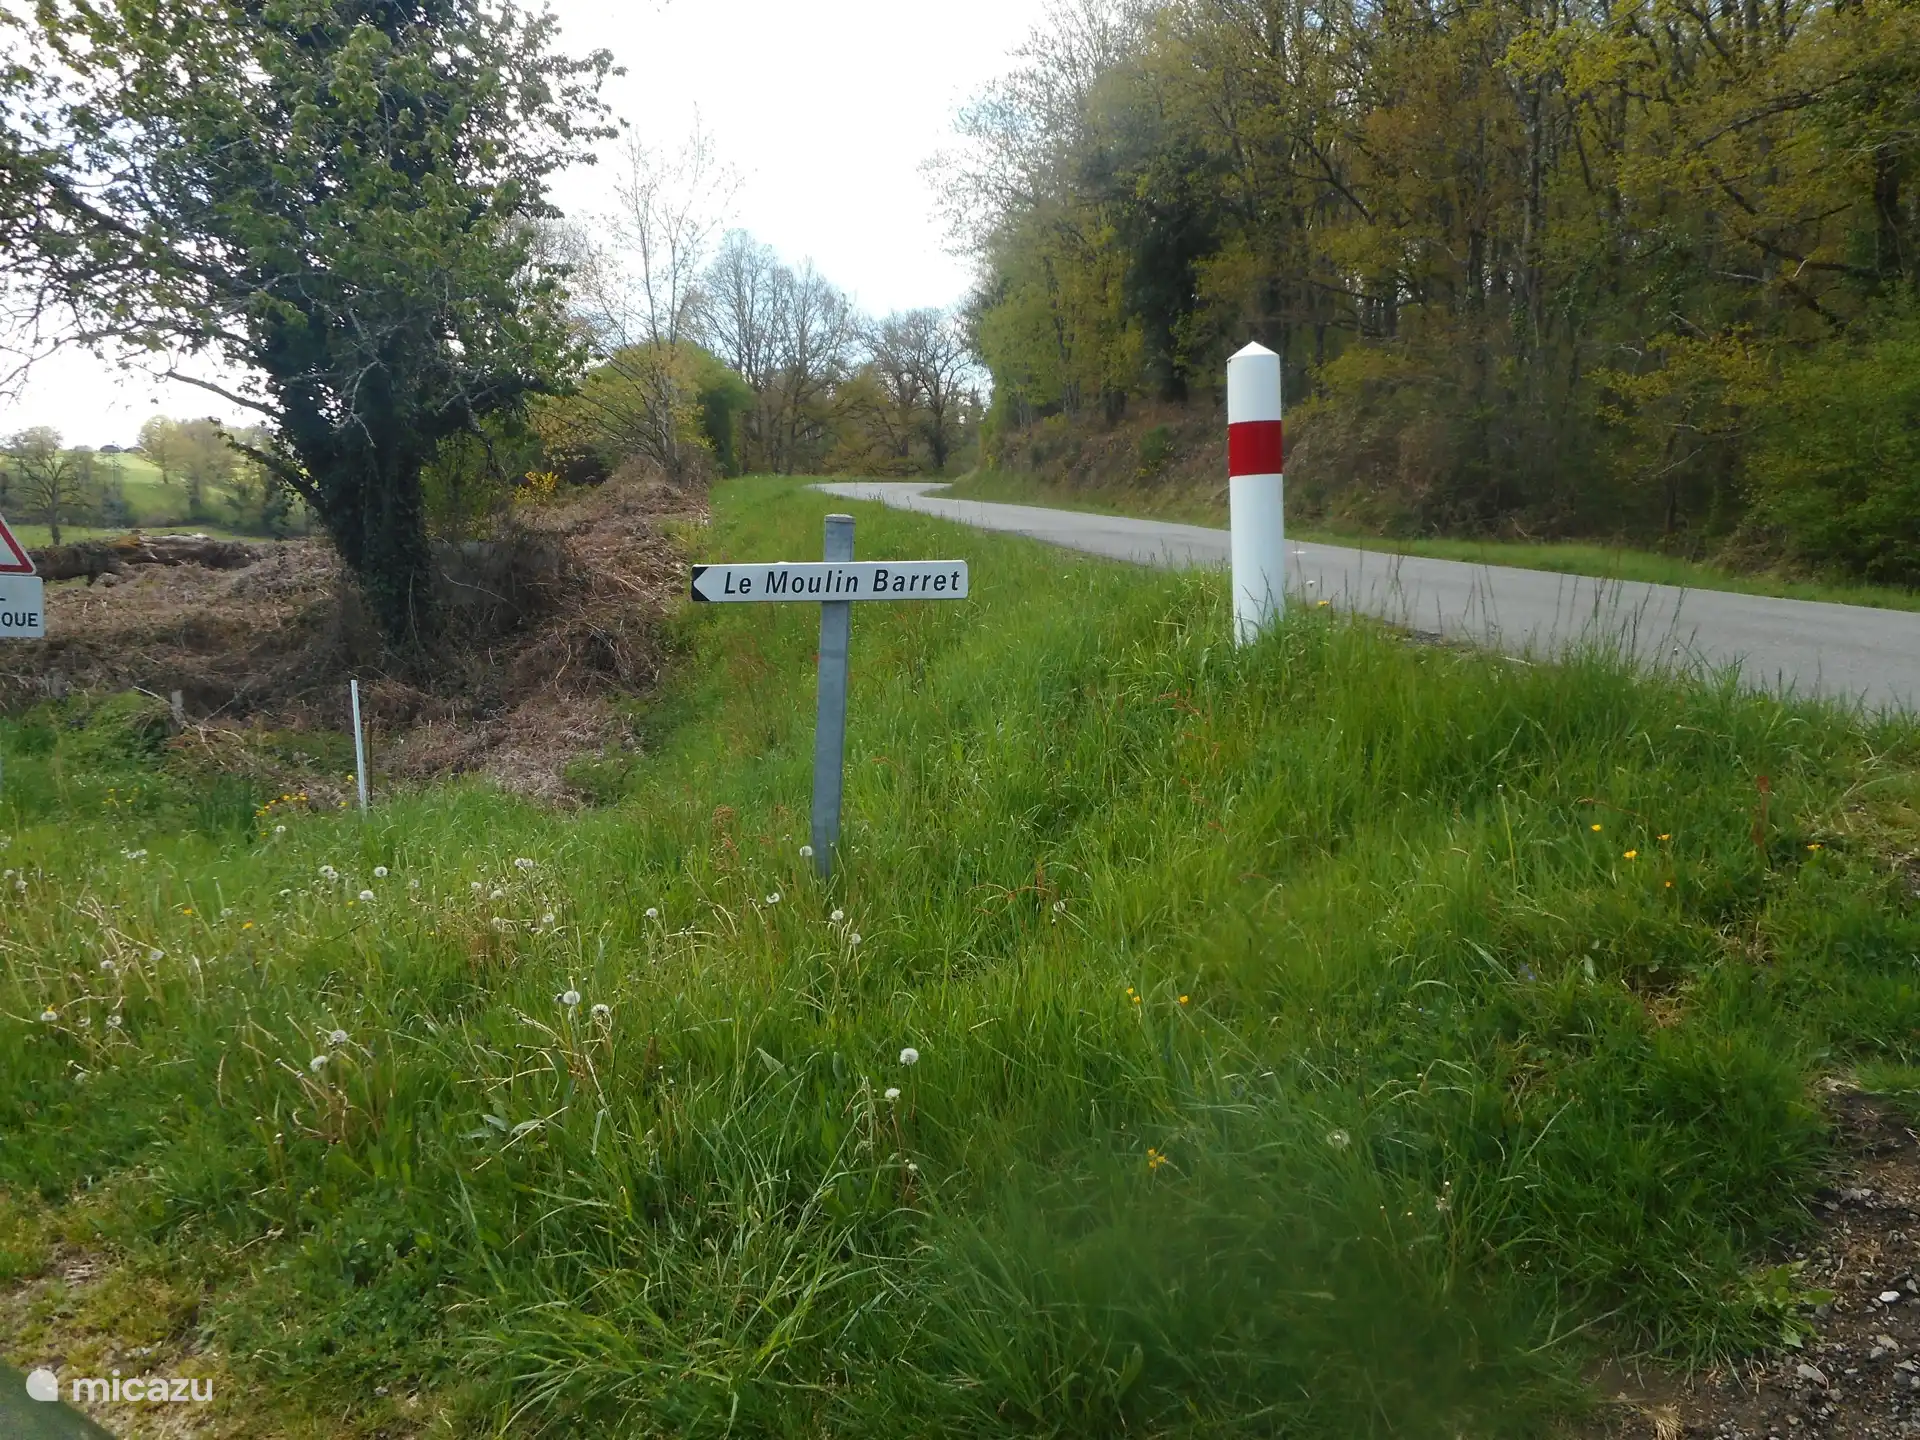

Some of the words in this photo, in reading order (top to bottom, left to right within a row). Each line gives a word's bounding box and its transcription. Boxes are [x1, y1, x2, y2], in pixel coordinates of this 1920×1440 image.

[724, 571, 752, 594] Le
[765, 570, 859, 594] Moulin
[872, 569, 960, 592] Barret
